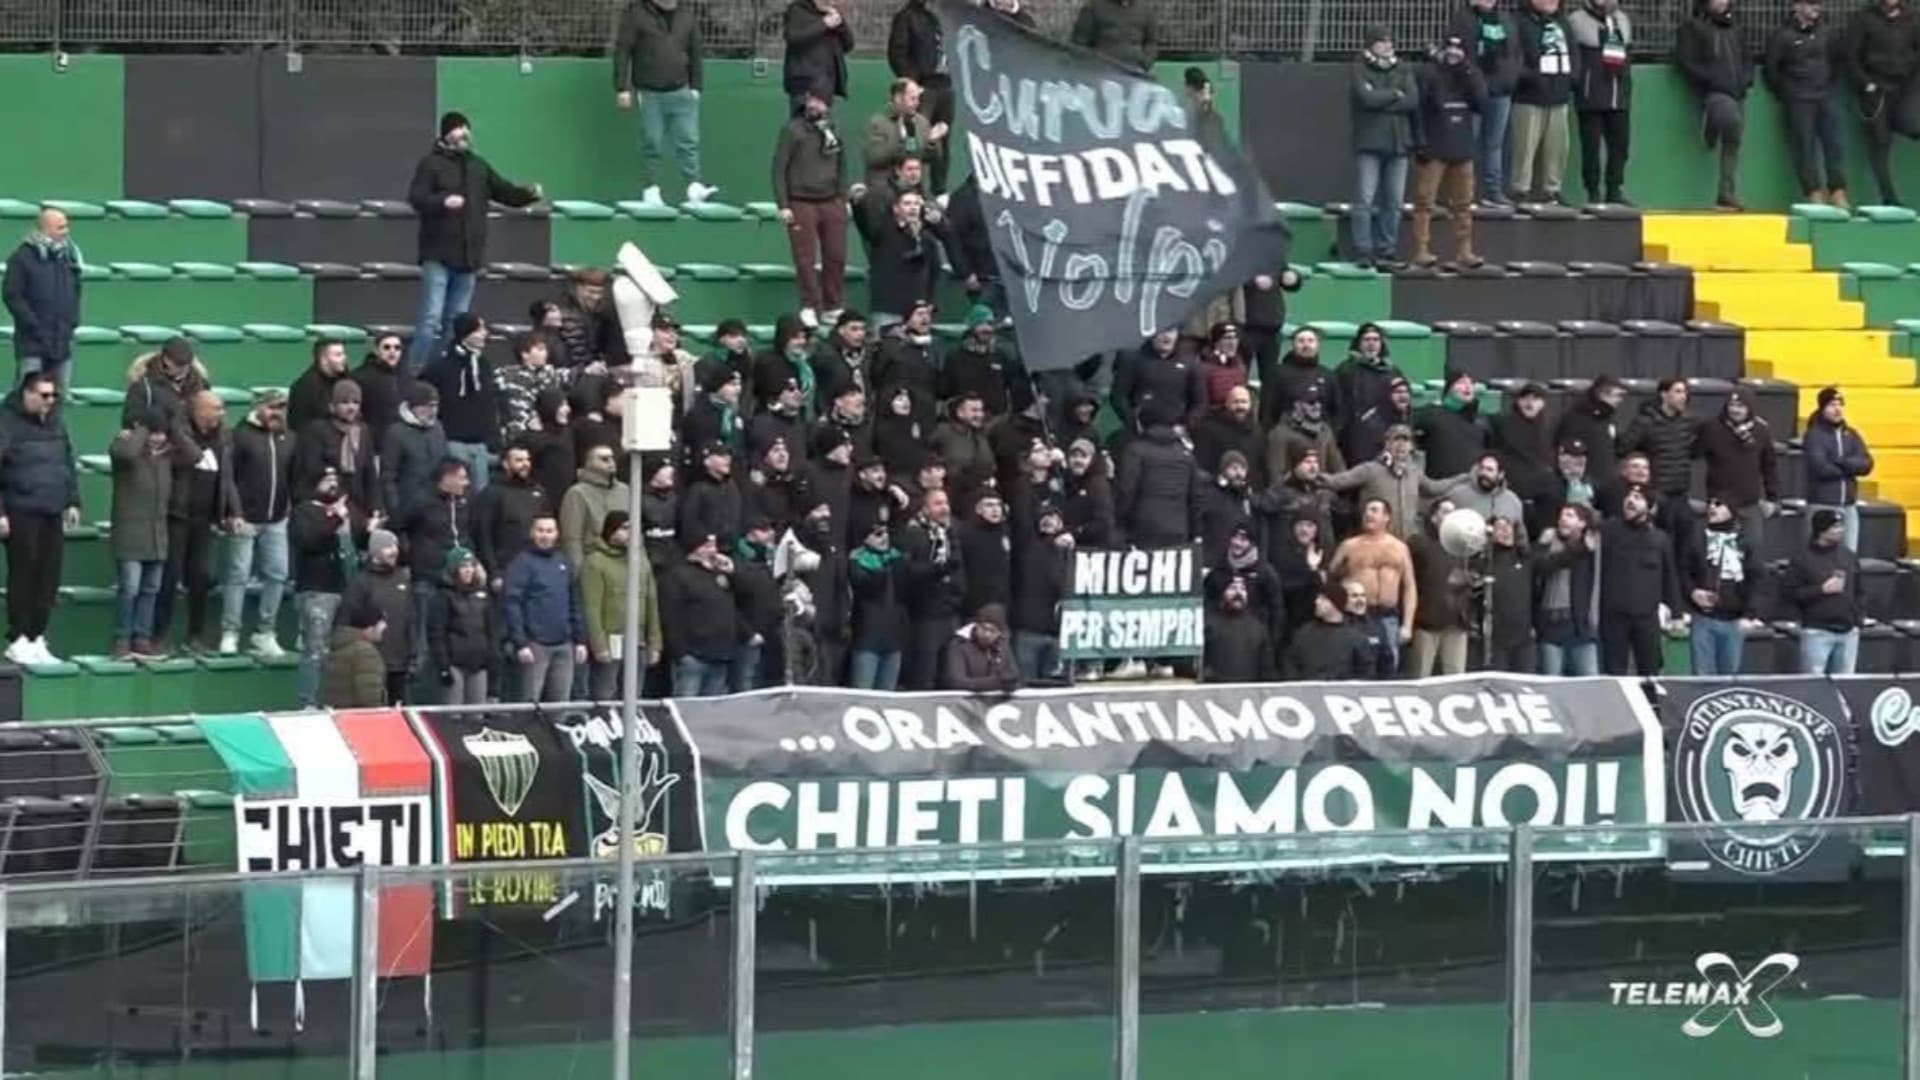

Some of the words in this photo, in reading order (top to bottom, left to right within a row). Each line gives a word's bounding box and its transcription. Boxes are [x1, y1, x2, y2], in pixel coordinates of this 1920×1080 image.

[957, 24, 1187, 144] Curva
[967, 131, 1237, 207] DIFFIDATI
[998, 188, 1227, 338] Volpi
[1074, 549, 1193, 595] MICHI
[1060, 610, 1105, 650] PER
[842, 706, 983, 753] ORA
[986, 697, 1316, 750] CANTIAMO
[456, 822, 475, 858] IN
[481, 822, 526, 858] PIEDI
[530, 820, 567, 857] TRA
[725, 776, 1027, 860] CHIETI
[1063, 765, 1375, 856] SIAMO
[1406, 762, 1620, 847] NOI!
